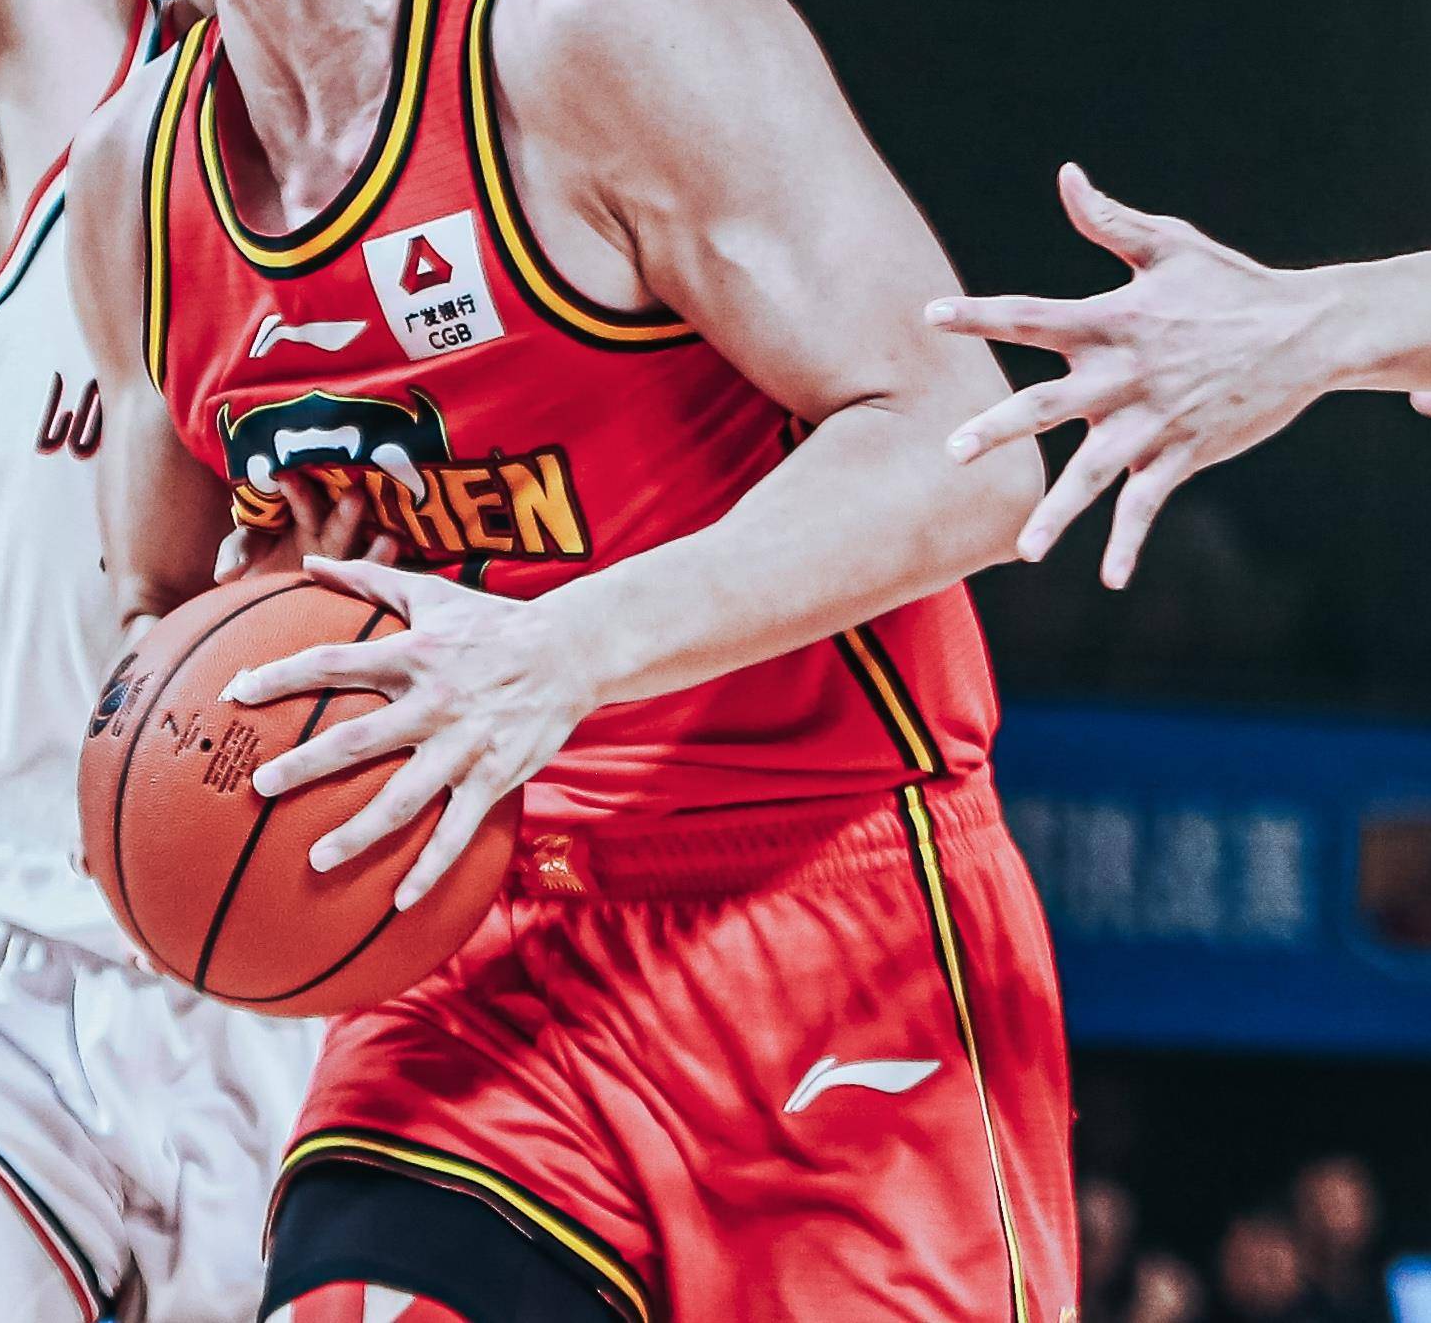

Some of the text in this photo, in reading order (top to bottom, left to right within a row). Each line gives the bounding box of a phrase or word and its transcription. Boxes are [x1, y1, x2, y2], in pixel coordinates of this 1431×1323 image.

[404, 294, 476, 333] 广发银行
[428, 323, 472, 350] CGB
